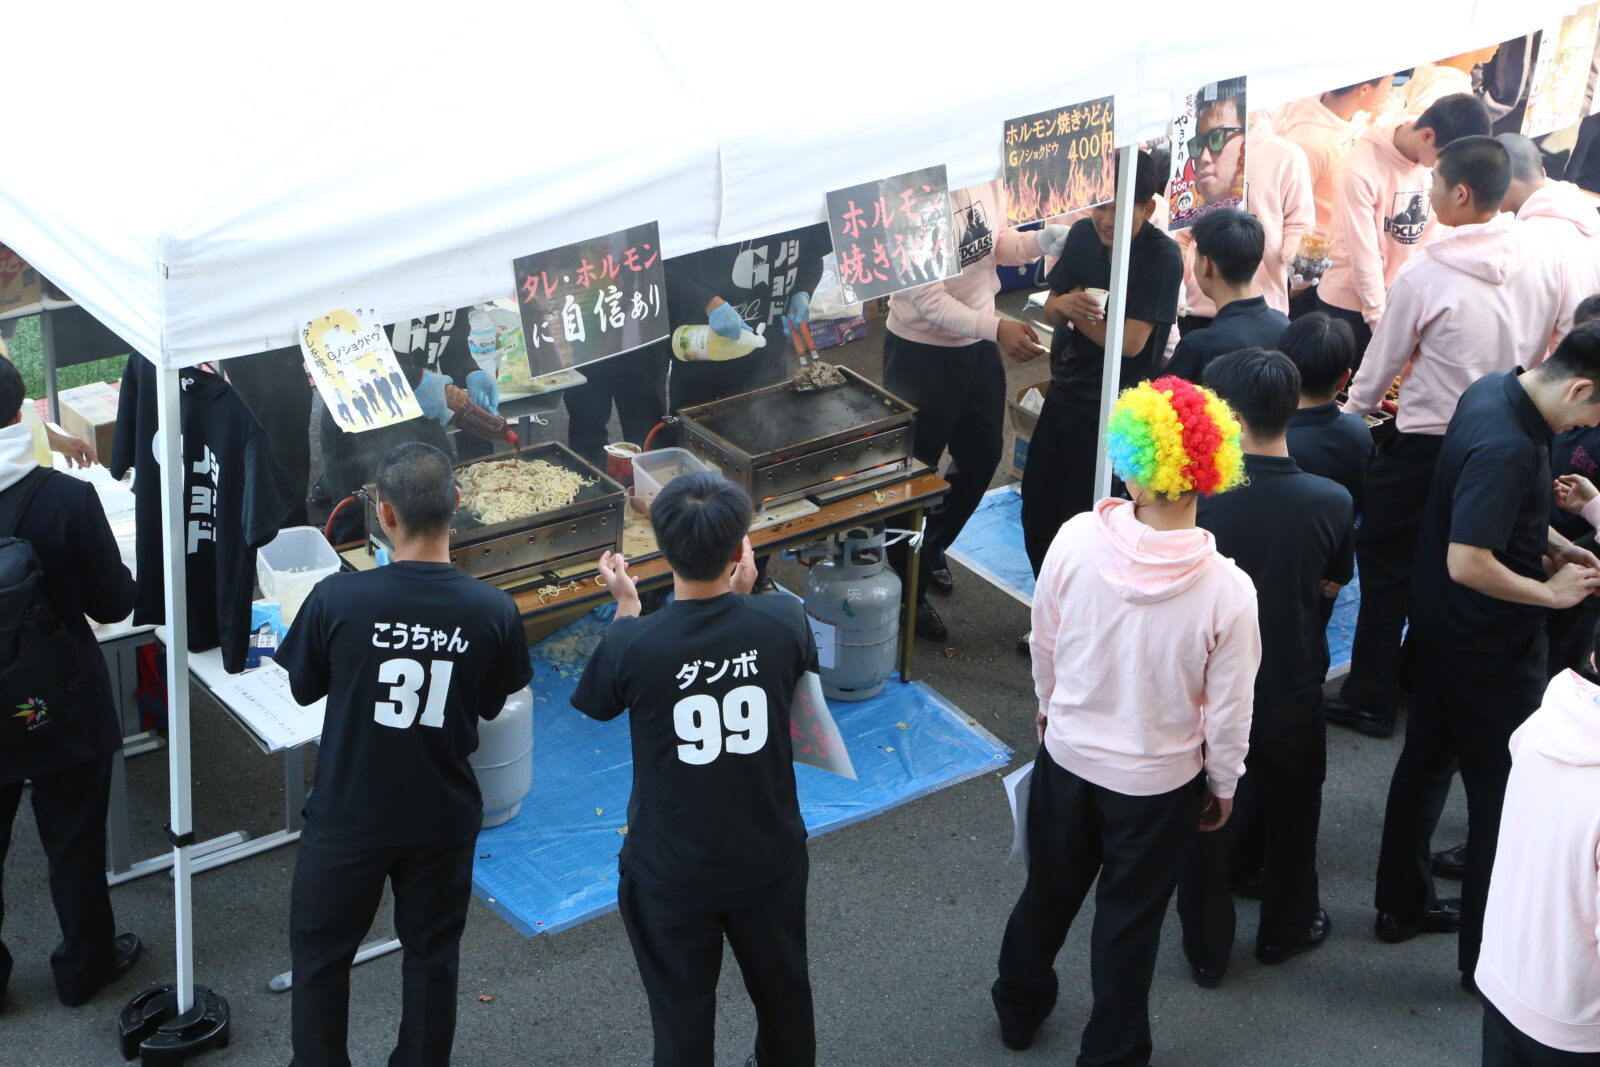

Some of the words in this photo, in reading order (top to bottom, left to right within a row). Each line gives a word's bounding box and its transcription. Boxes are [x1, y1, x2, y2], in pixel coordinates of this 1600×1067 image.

[1006, 102, 1113, 146] ホルモン焼きうどん
[1068, 130, 1113, 162] 400円
[1009, 142, 1059, 166] Gノショクドウ
[842, 185, 946, 239] ホルモン
[521, 244, 657, 303] タレ・ホルモン
[839, 225, 953, 285] 焼きうどん
[533, 284, 660, 348] に自信あり
[372, 622, 469, 653] こうちゃん
[374, 658, 454, 729] 31
[676, 650, 759, 690] ダンボ
[673, 685, 768, 766] 99
